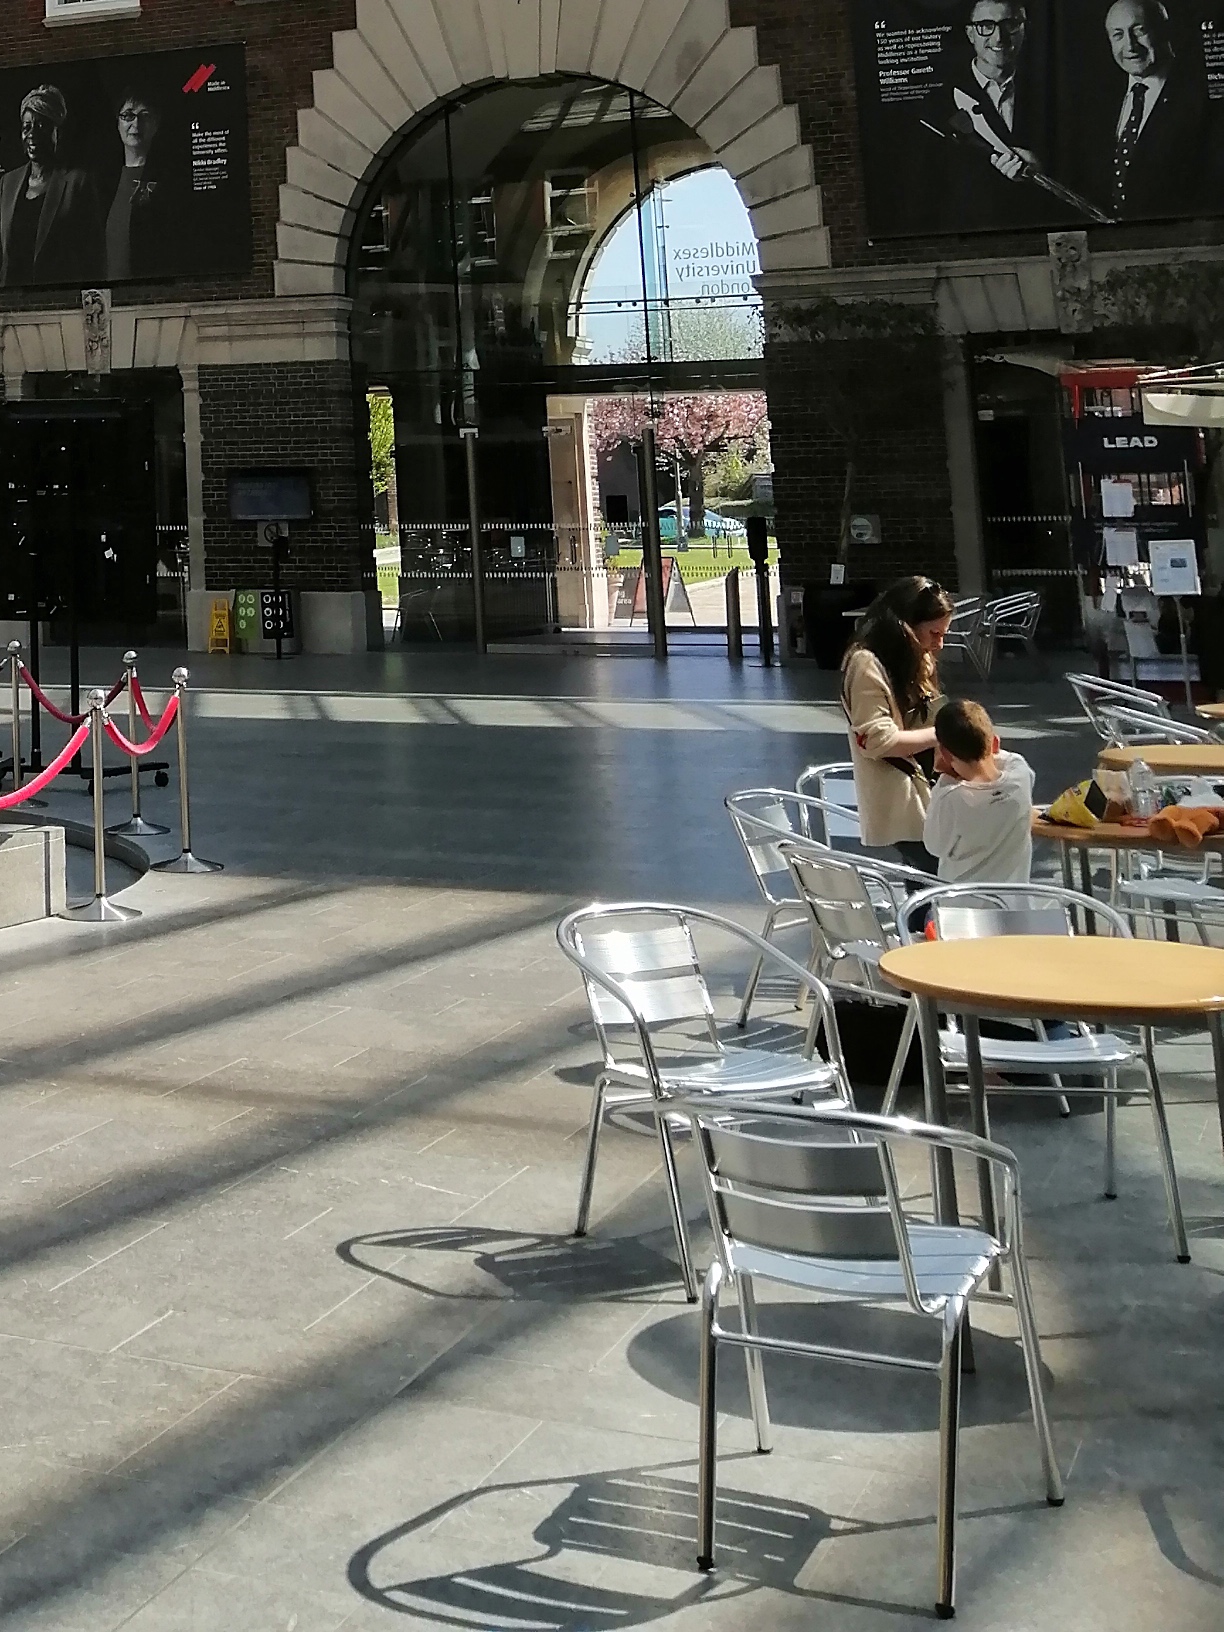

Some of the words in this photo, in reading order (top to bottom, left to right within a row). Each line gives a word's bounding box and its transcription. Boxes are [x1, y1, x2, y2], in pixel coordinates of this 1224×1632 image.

[879, 69, 910, 77] Professor
[911, 66, 933, 74] Gareth
[1103, 436, 1158, 448] LEAD
